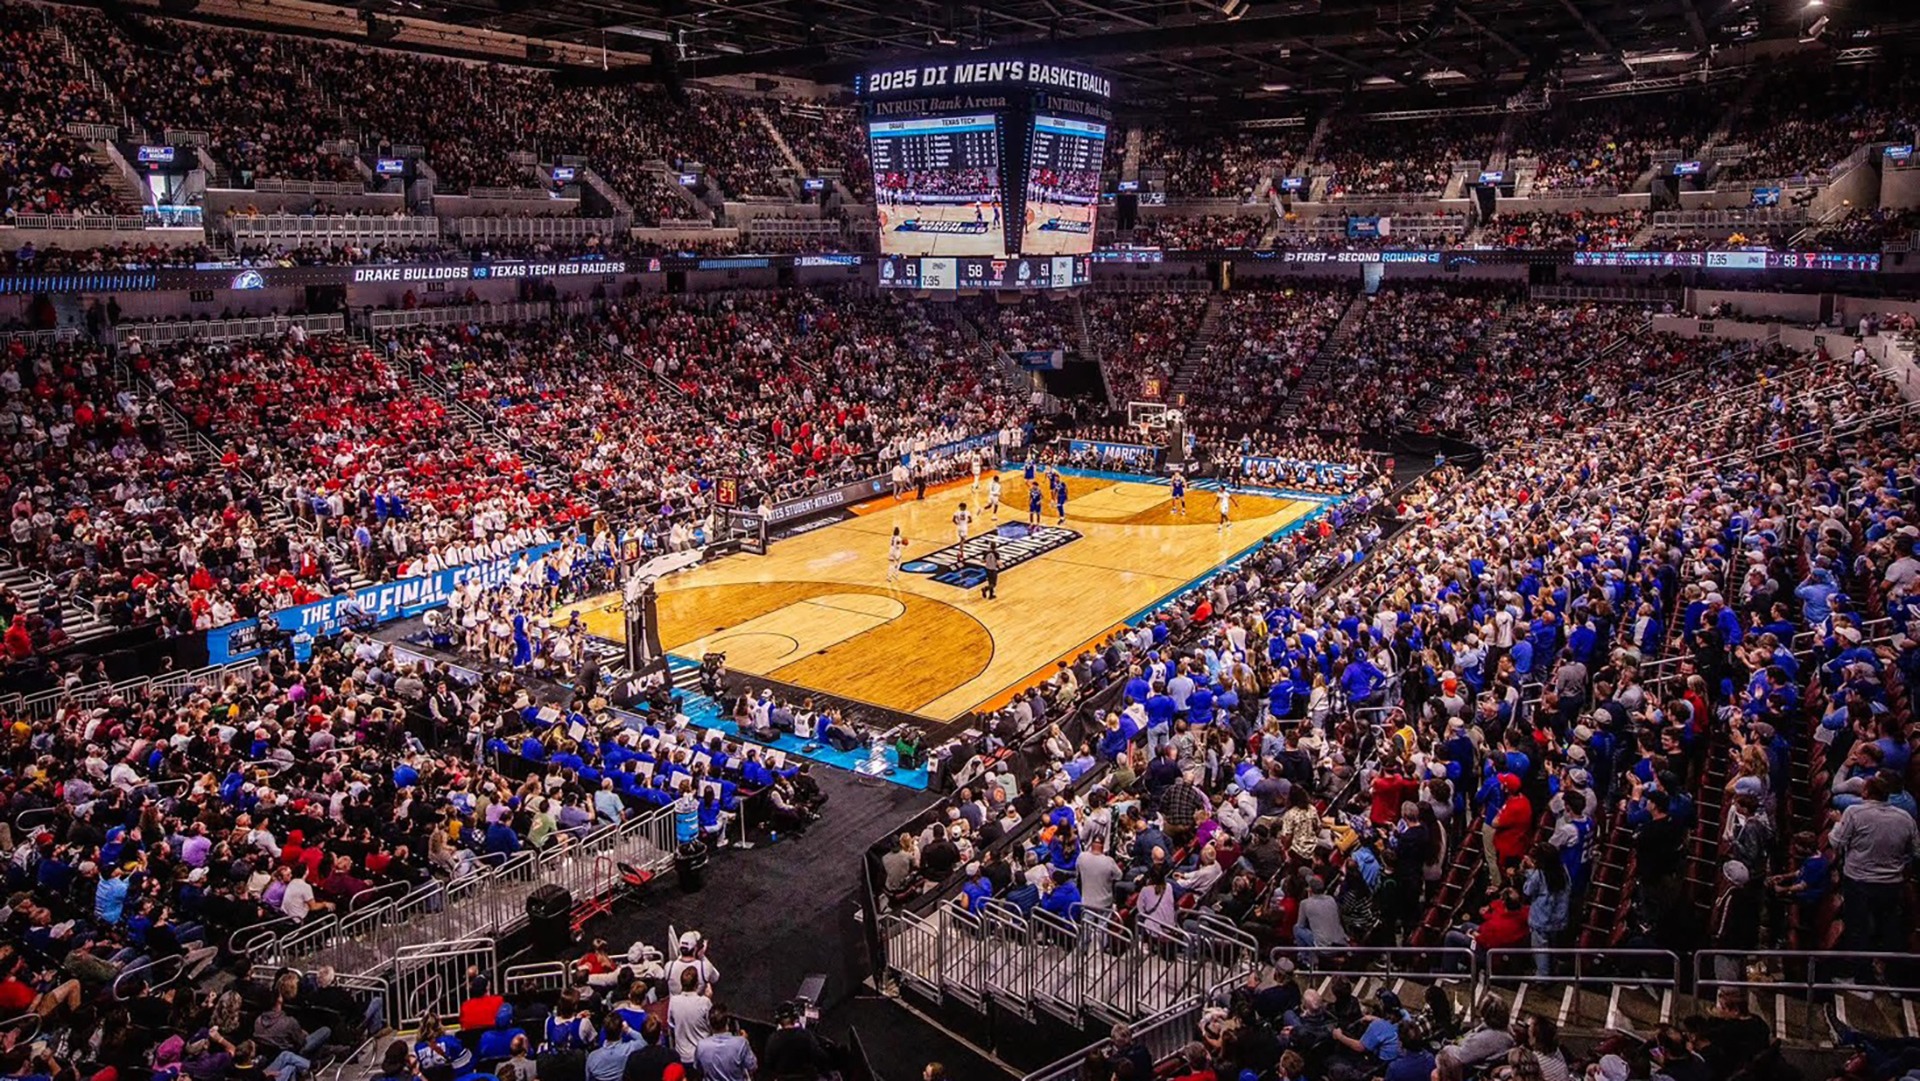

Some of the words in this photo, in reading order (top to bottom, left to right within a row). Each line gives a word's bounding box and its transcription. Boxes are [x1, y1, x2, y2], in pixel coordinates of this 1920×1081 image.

[869, 68, 917, 92] 2025
[922, 65, 949, 87] DI
[954, 61, 1024, 84] MEN'S
[1028, 62, 1103, 95] BASKETBALL
[876, 98, 928, 115] INTRUST
[929, 95, 963, 110] Bank
[964, 94, 1006, 109] Arena
[1296, 252, 1327, 263] FIRST
[1337, 252, 1380, 263] SECOND
[1381, 252, 1427, 263] ROUNDS
[1690, 253, 1701, 265] 51
[1709, 253, 1727, 265] 7:35
[1783, 254, 1798, 267] 58
[355, 267, 400, 282] DRAKE
[404, 266, 469, 280] BULLDOGS
[473, 266, 487, 278] VS
[490, 265, 526, 277] TEXAS
[528, 263, 556, 276] TECH
[558, 263, 579, 275] RED
[581, 262, 625, 274] RAIDERS
[906, 264, 917, 277] 51
[967, 264, 983, 277] 58
[1040, 263, 1050, 277] 51
[922, 275, 940, 287] 7:35
[785, 491, 844, 518] STUDENT-ATHLETES
[302, 602, 332, 626] THE
[335, 591, 377, 617] RAD
[380, 575, 449, 615] FINAL
[323, 620, 335, 631] TO
